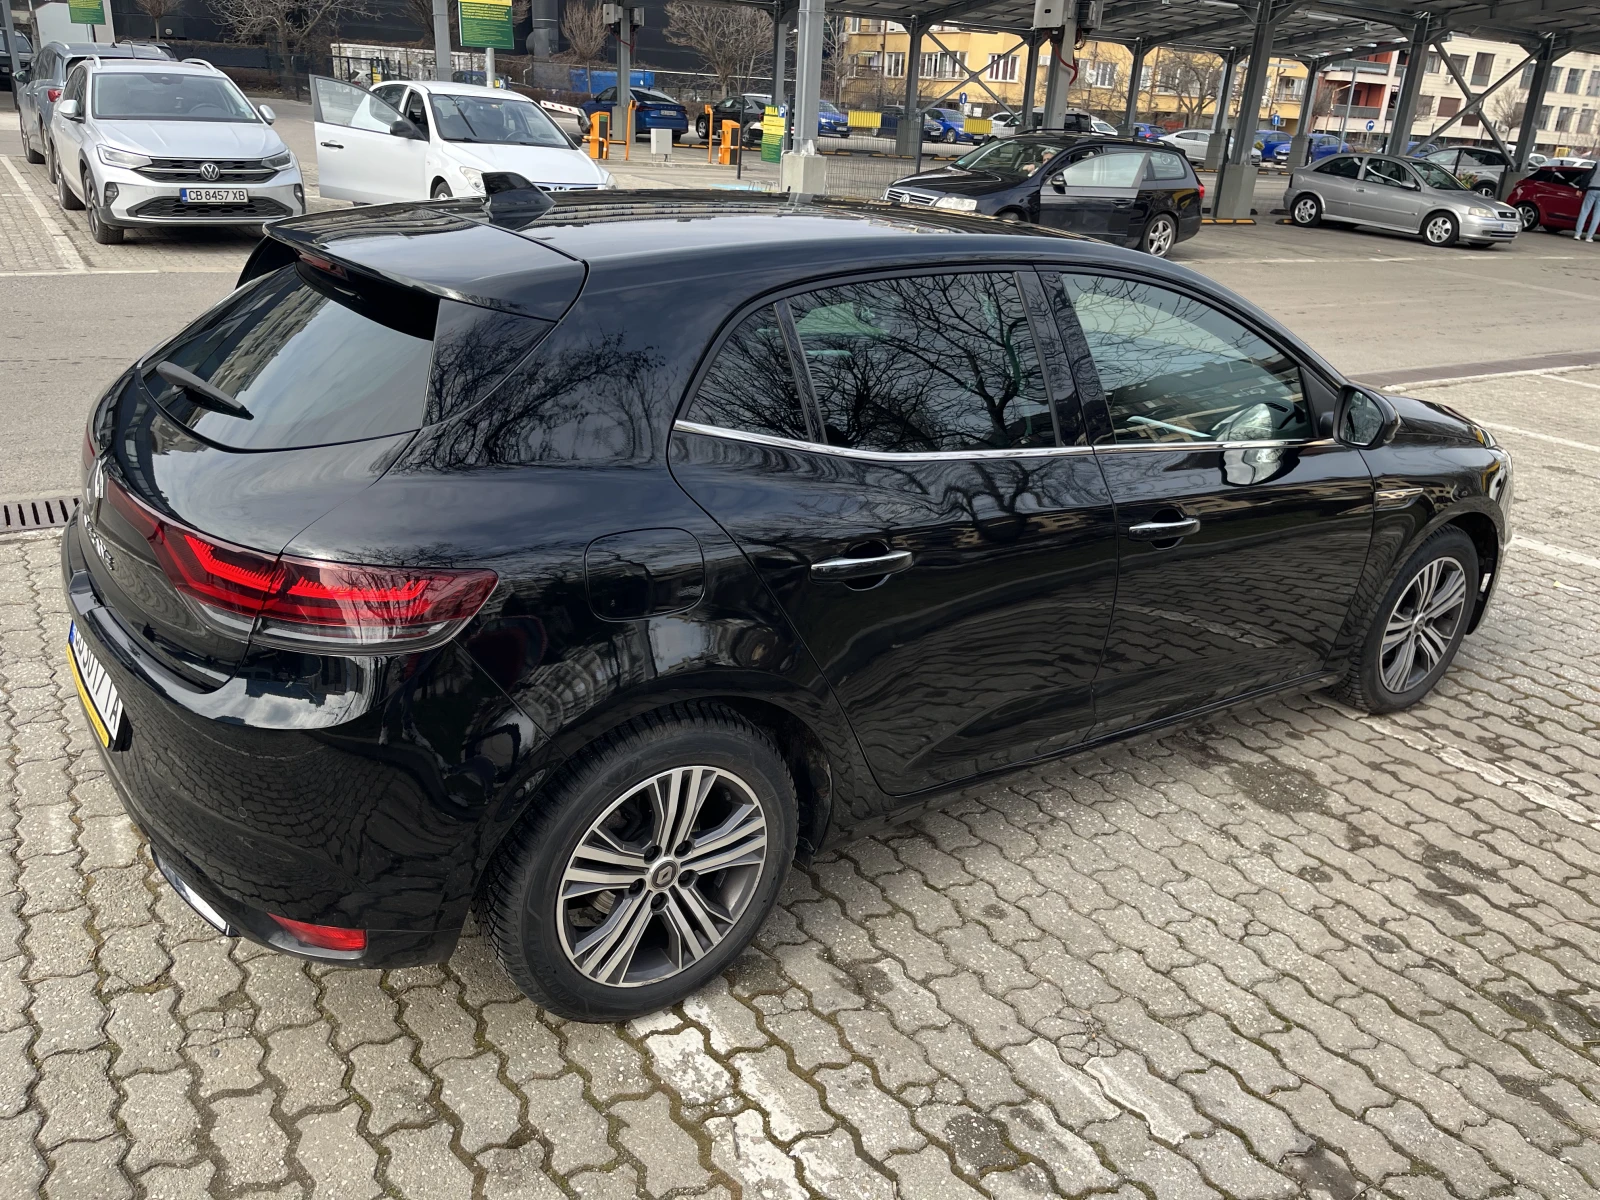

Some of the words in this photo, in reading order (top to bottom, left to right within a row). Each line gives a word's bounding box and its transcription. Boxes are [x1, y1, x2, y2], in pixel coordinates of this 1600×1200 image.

[188, 190, 203, 201] CB
[204, 190, 230, 201] 8457
[231, 190, 246, 201] XB
